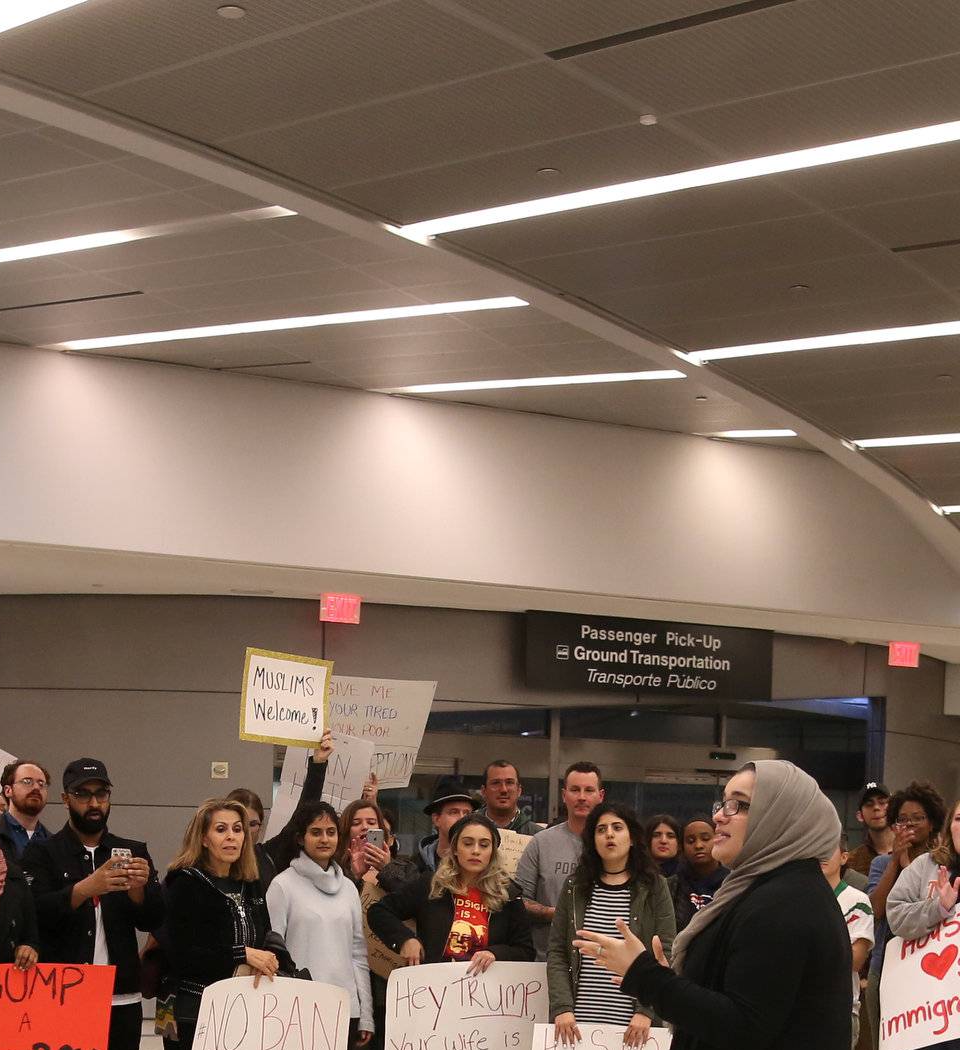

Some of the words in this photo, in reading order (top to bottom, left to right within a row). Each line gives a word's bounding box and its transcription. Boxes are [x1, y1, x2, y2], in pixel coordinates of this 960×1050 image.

[581, 625, 657, 646] Passenger
[666, 631, 722, 651] Pick-Up
[574, 646, 627, 664] Ground
[630, 649, 731, 671] Transportation
[252, 665, 315, 698] MUSLIMS
[587, 668, 662, 688] Transporte
[253, 698, 319, 731] Welcome!
[17, 1011, 32, 1033] A
[881, 995, 960, 1041] immigr
[503, 1031, 521, 1048] is
